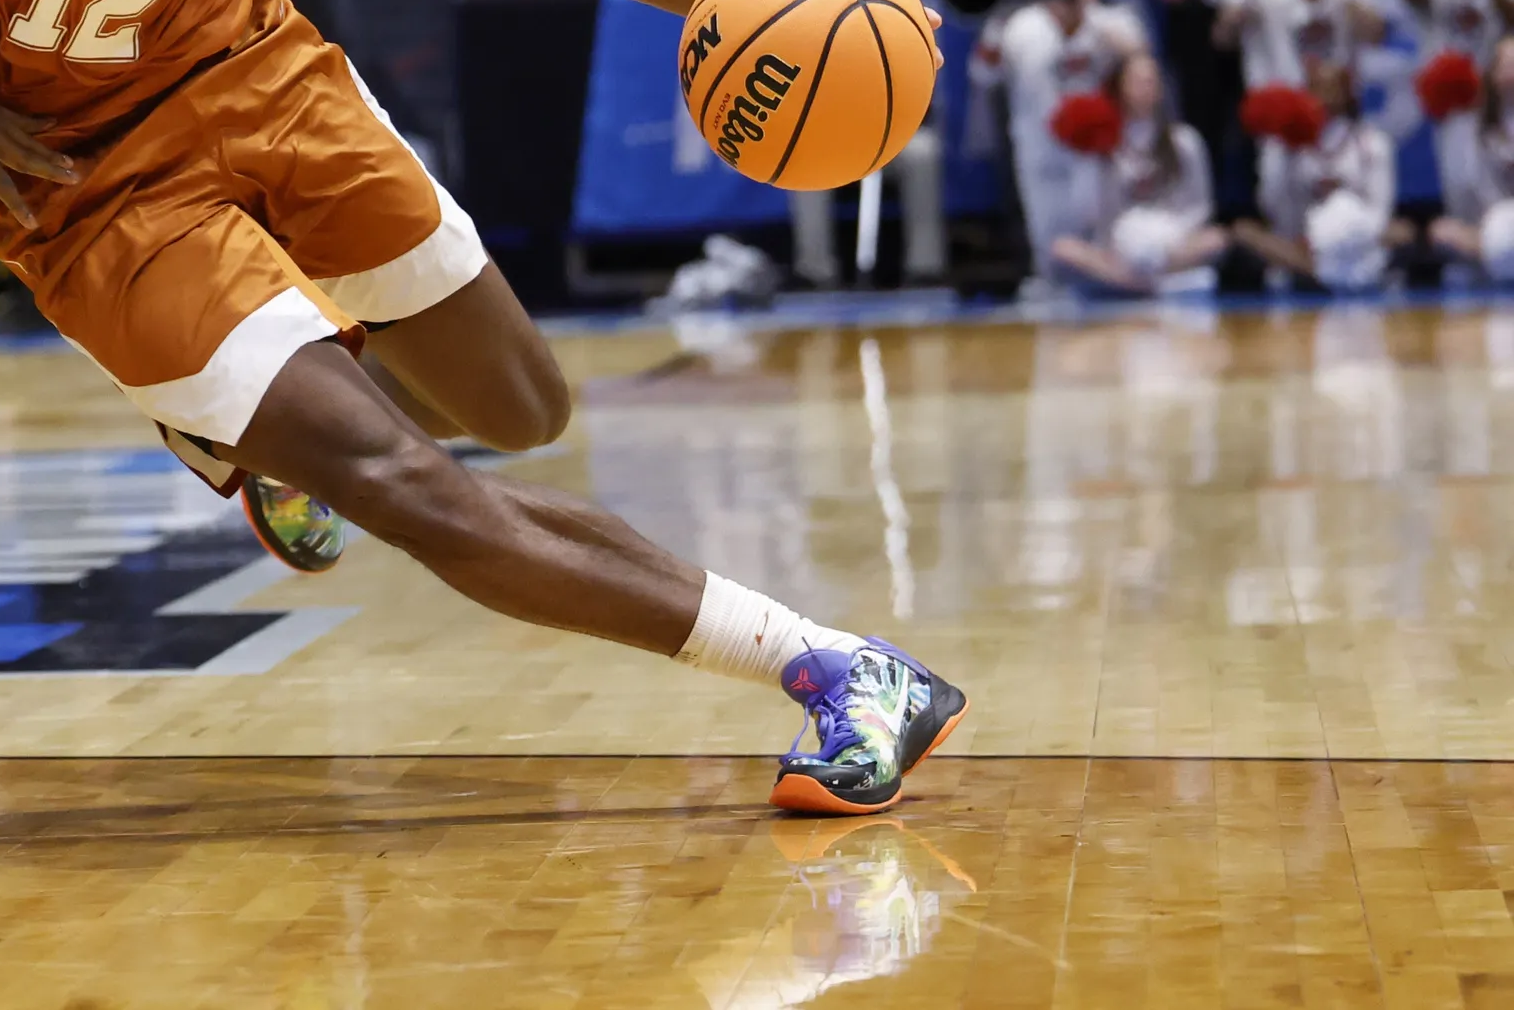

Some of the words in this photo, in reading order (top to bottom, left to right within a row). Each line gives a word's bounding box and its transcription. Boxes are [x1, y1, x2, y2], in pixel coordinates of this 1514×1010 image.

[680, 12, 722, 96] NCA
[719, 92, 731, 112] EVO
[714, 112, 722, 130] NXT
